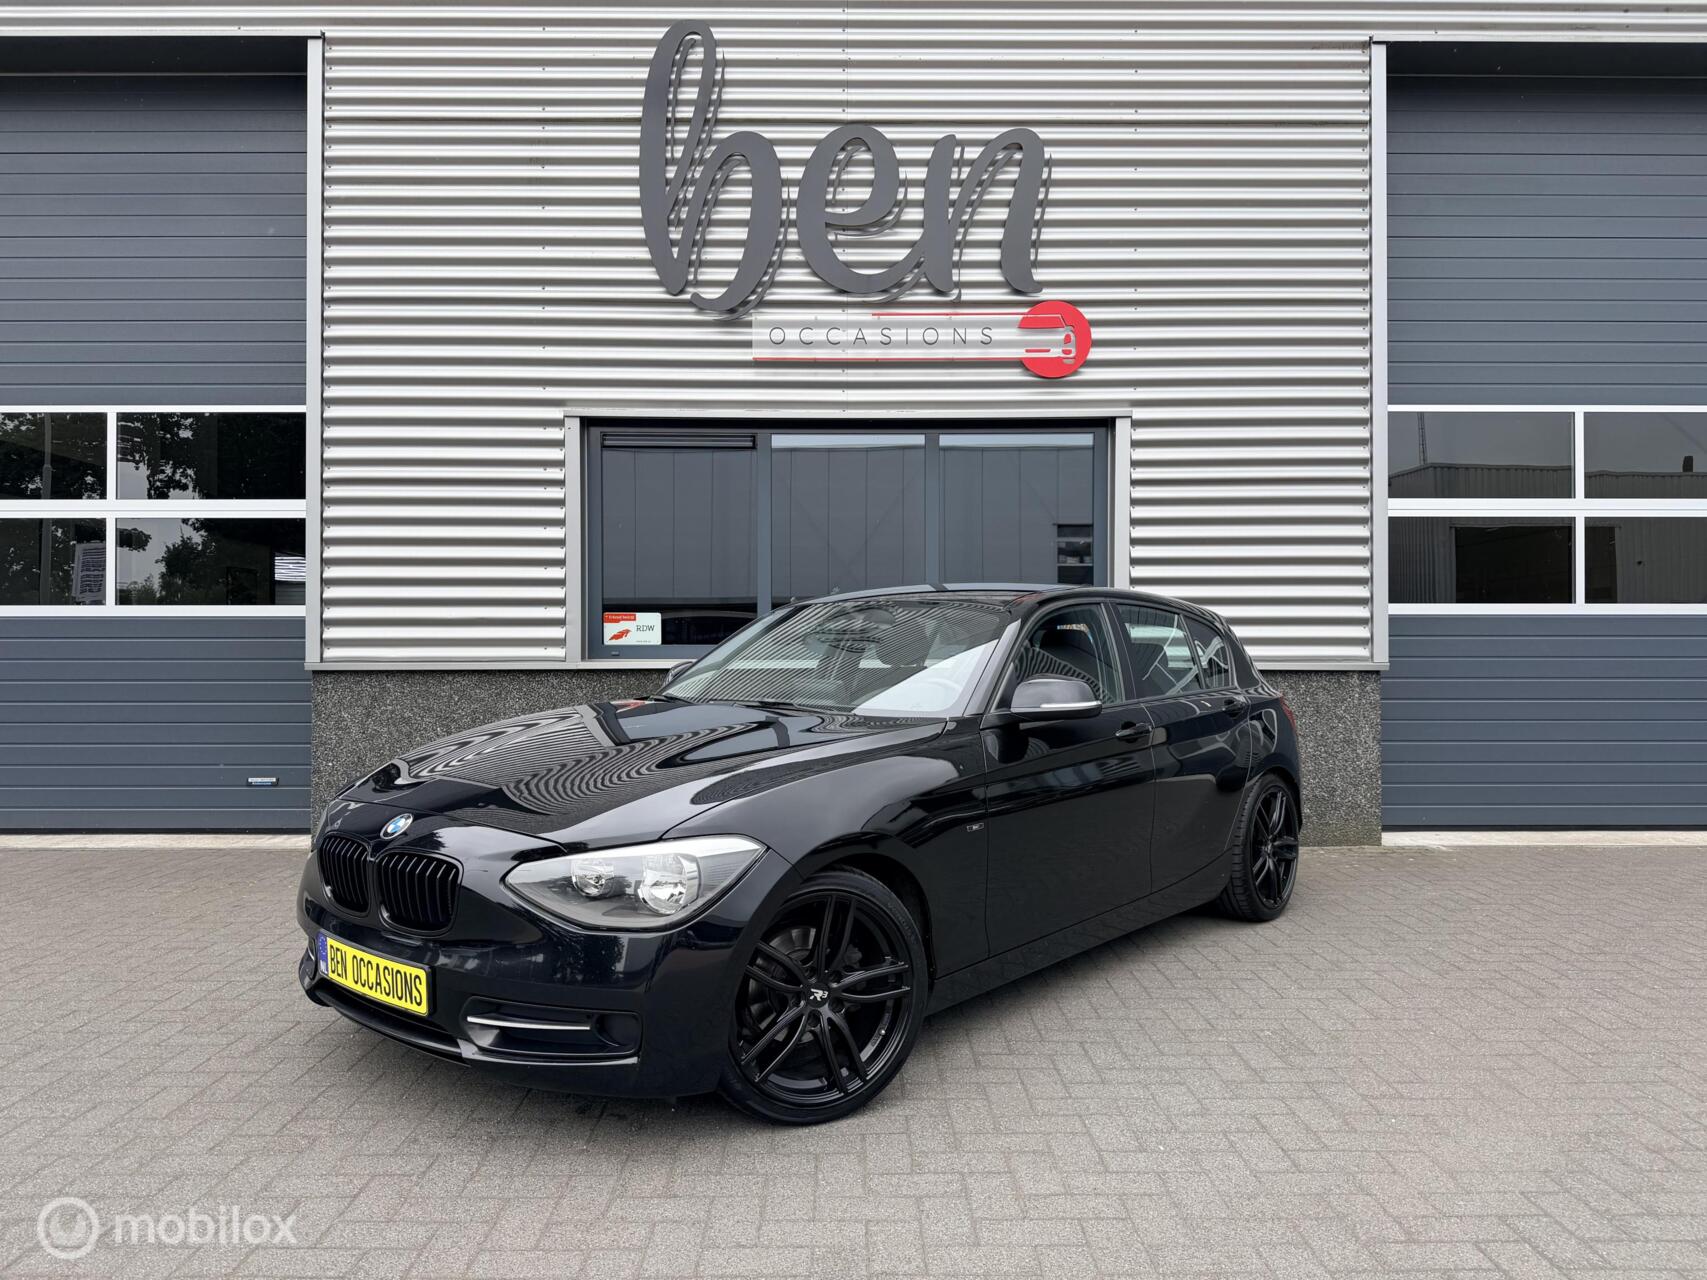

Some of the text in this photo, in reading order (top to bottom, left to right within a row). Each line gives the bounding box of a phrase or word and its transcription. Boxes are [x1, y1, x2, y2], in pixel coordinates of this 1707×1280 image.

[639, 19, 1044, 312] ben
[768, 326, 993, 346] OCCASIONS
[329, 944, 423, 1007] BEN OCCASIONS
